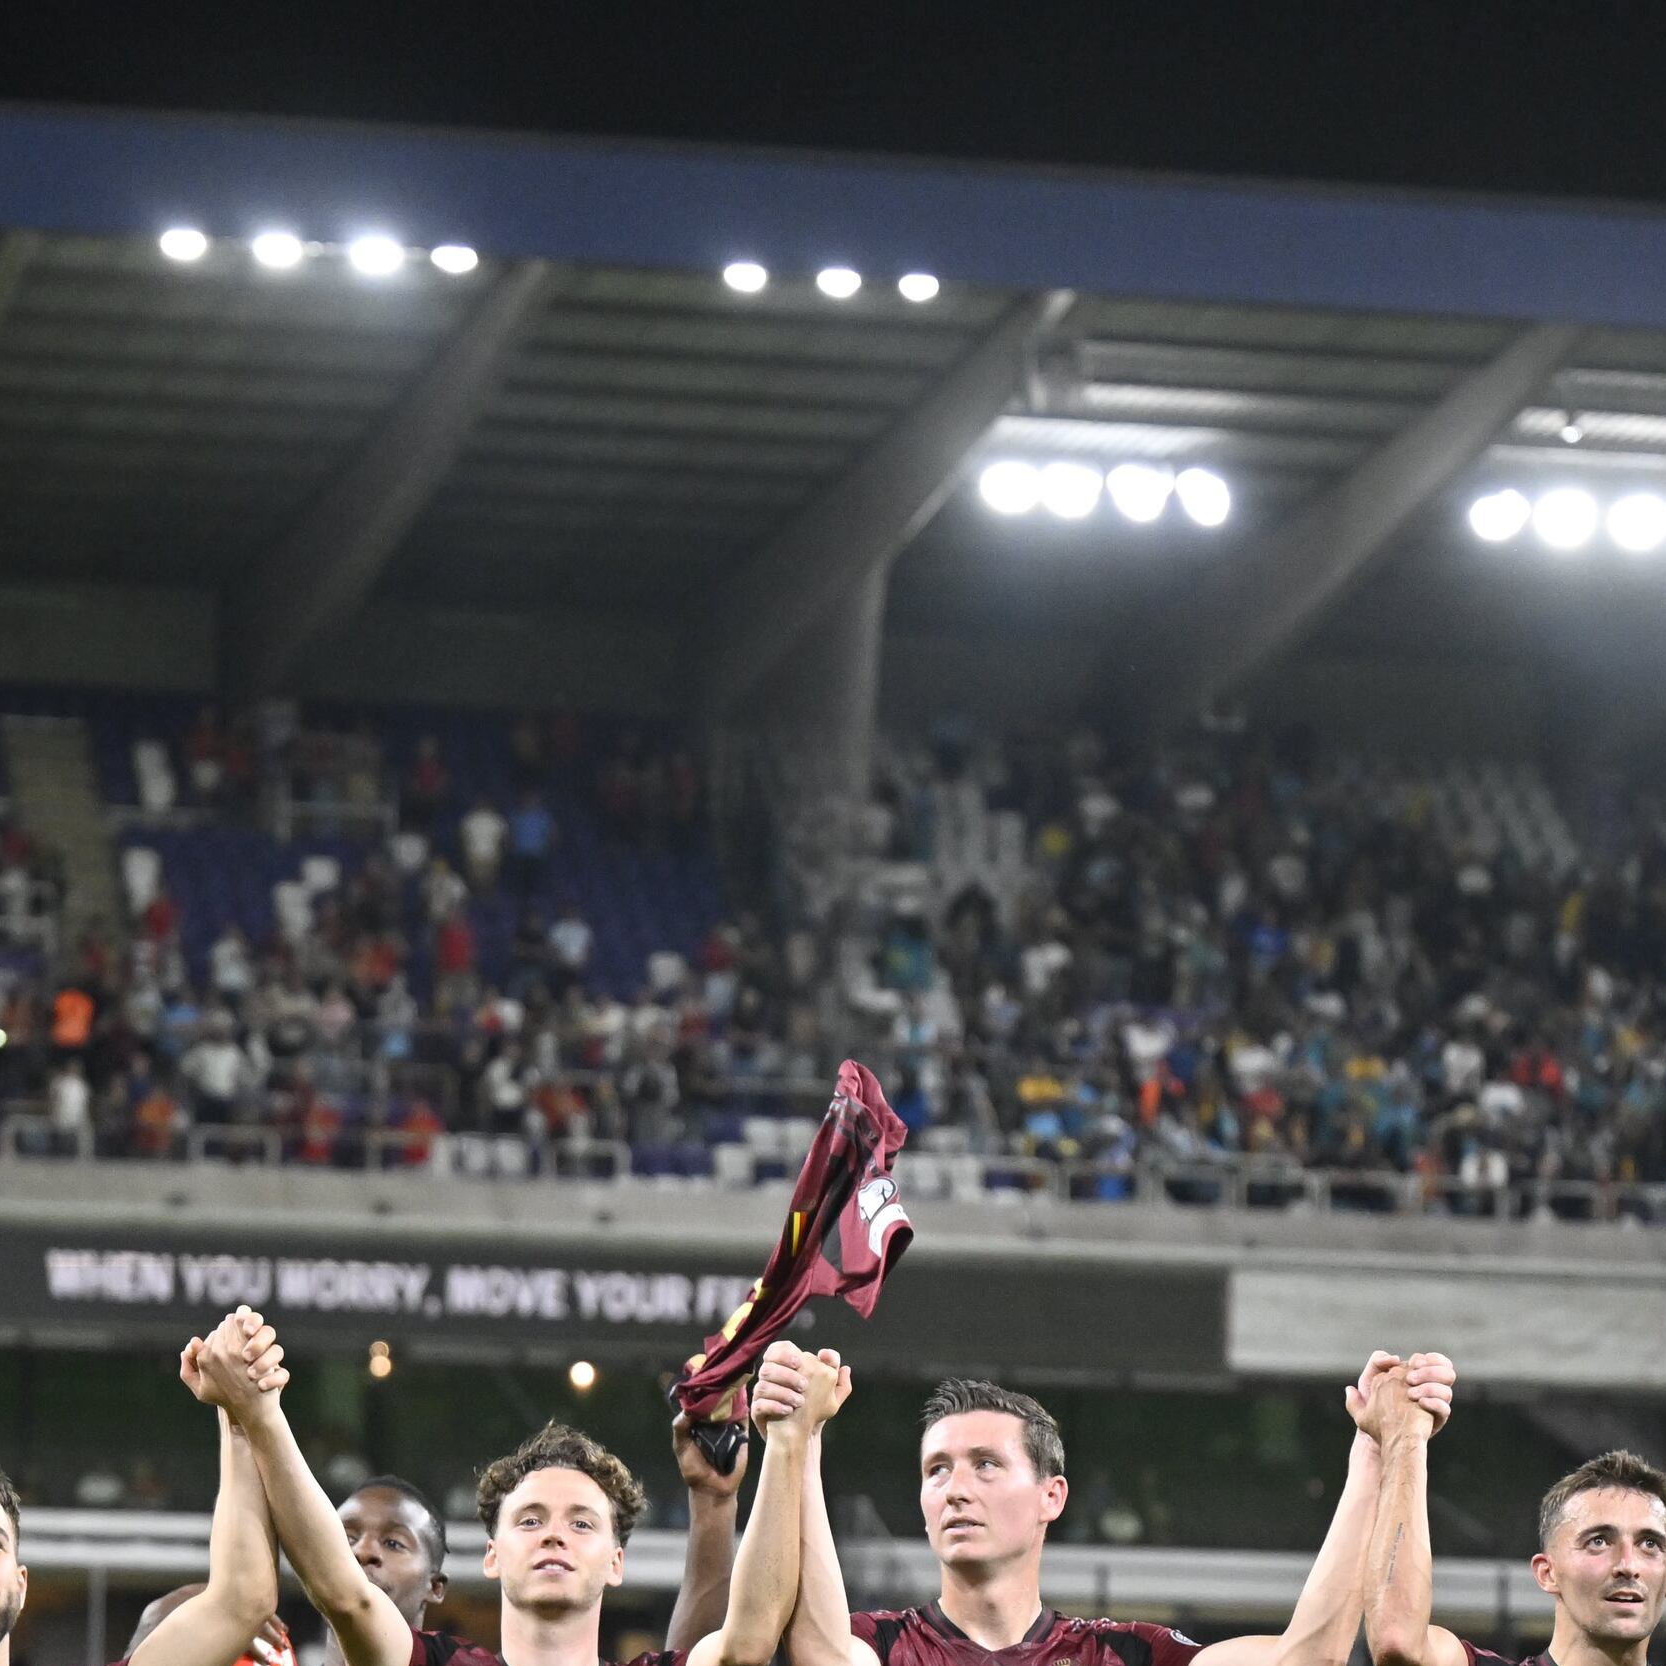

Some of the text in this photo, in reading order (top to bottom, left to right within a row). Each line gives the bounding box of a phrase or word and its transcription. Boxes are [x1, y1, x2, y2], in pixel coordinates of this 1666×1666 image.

[45, 1248, 175, 1303] WHEN
[179, 1253, 272, 1306] YOU
[444, 1263, 567, 1320] MOVE
[573, 1270, 693, 1325] YOUR
